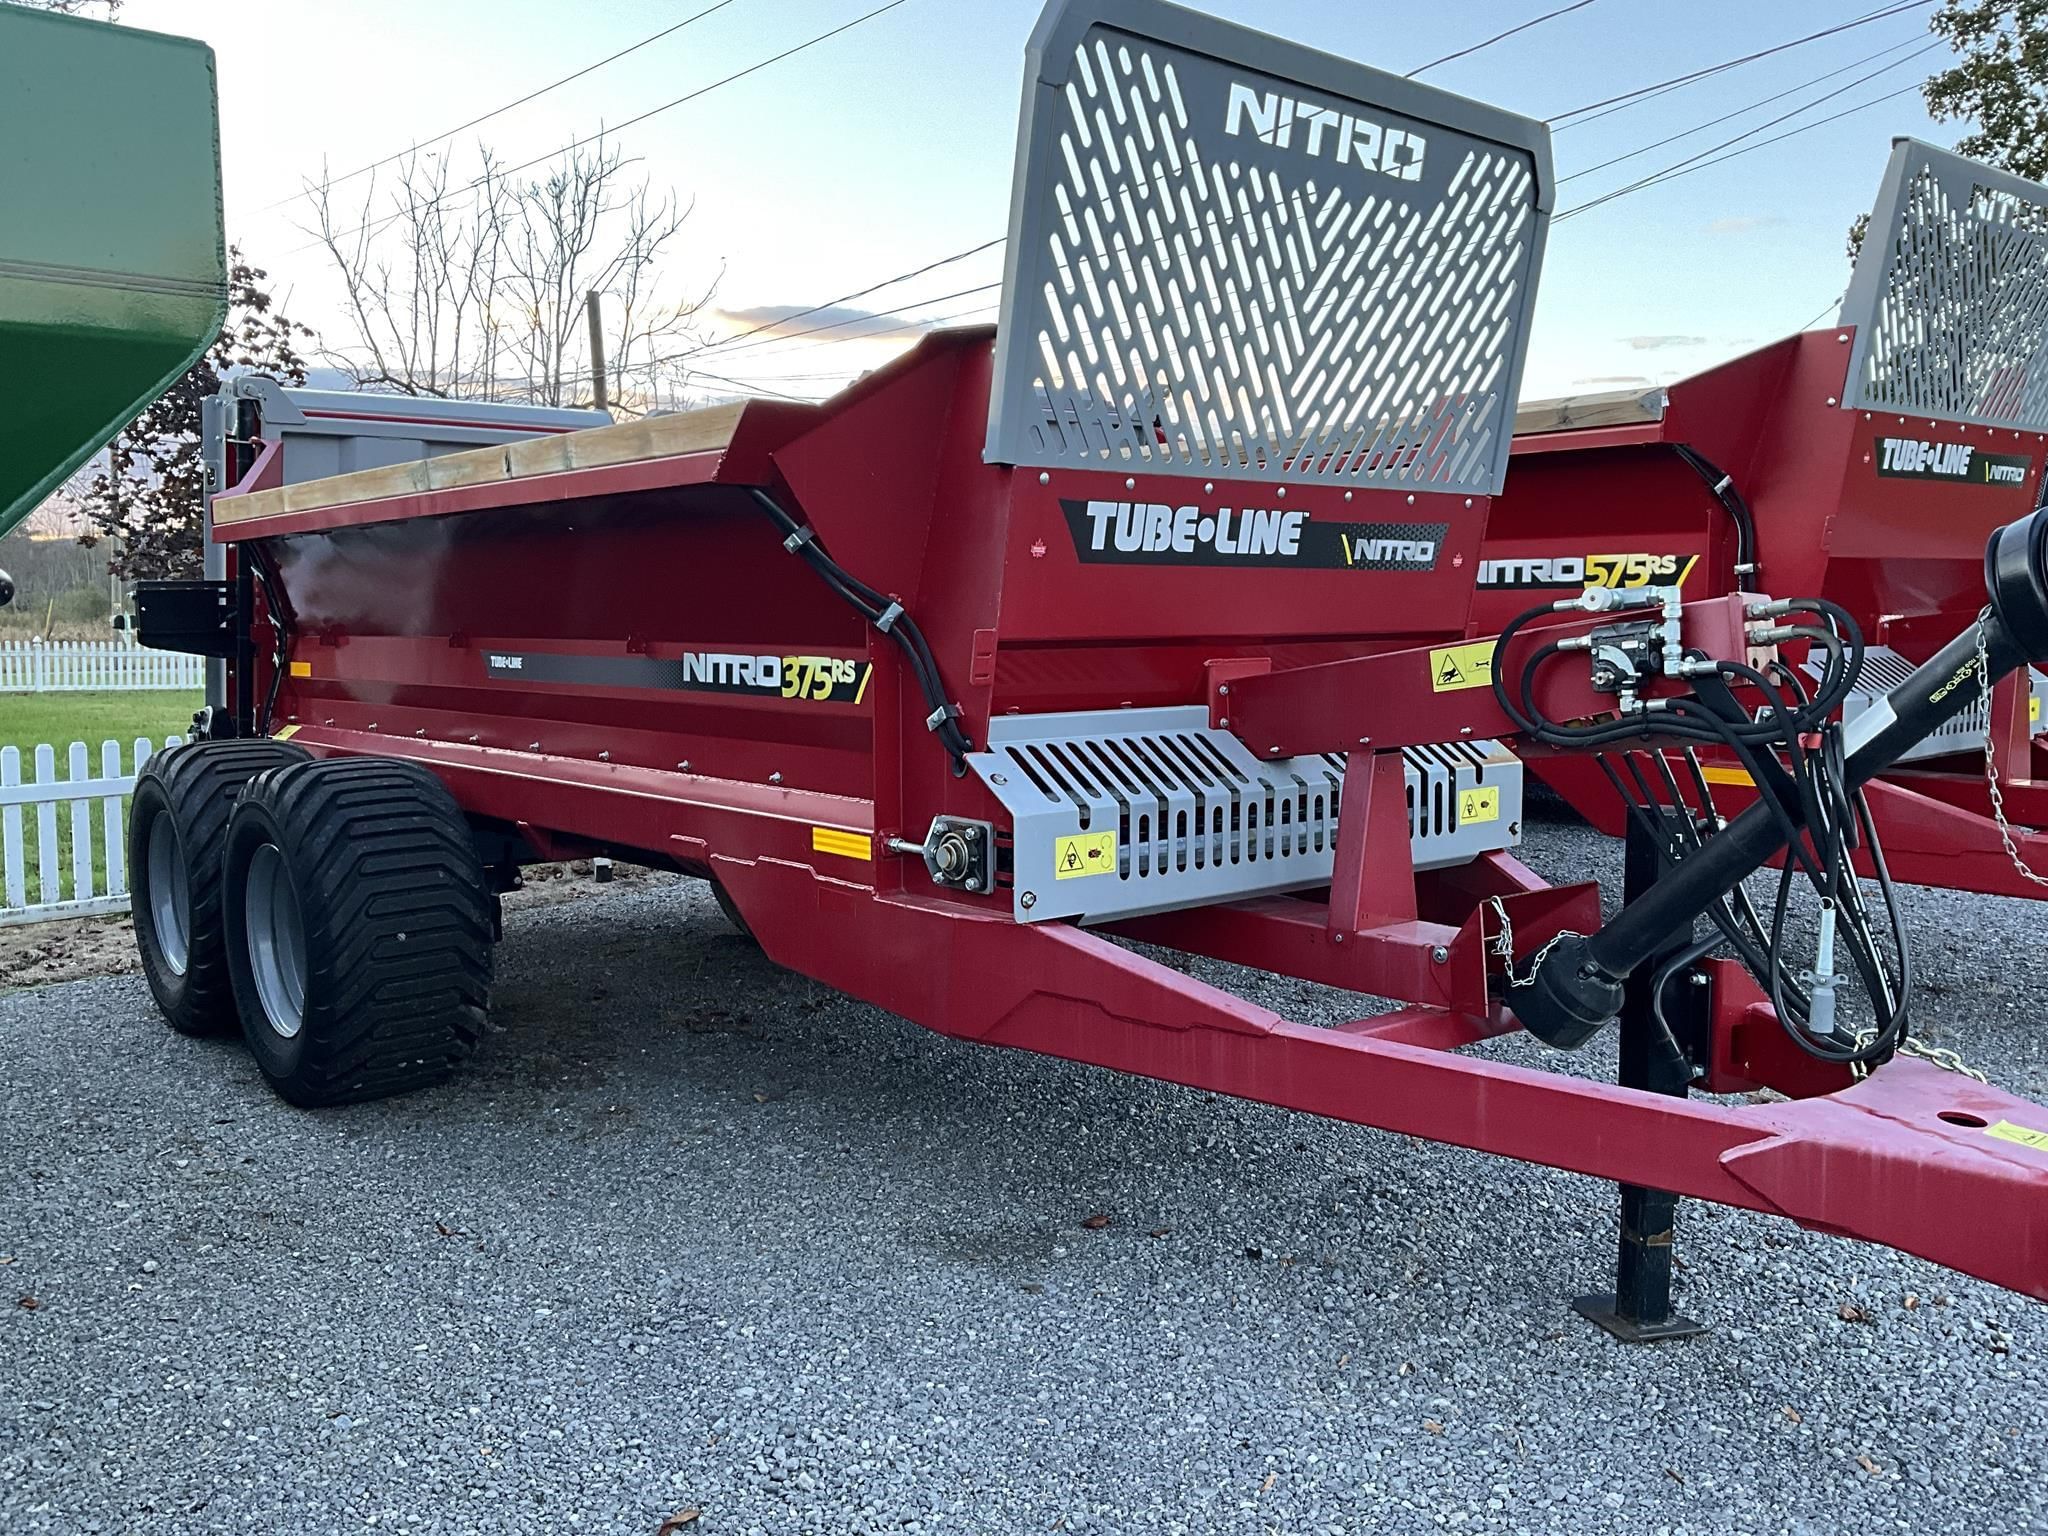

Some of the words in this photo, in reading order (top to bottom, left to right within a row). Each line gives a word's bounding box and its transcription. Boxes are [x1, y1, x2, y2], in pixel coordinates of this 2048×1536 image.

[1225, 83, 1426, 182] NITRO
[1990, 465, 2025, 482] NITRO
[1355, 538, 1435, 561] NITRO
[683, 652, 781, 687] NITRO
